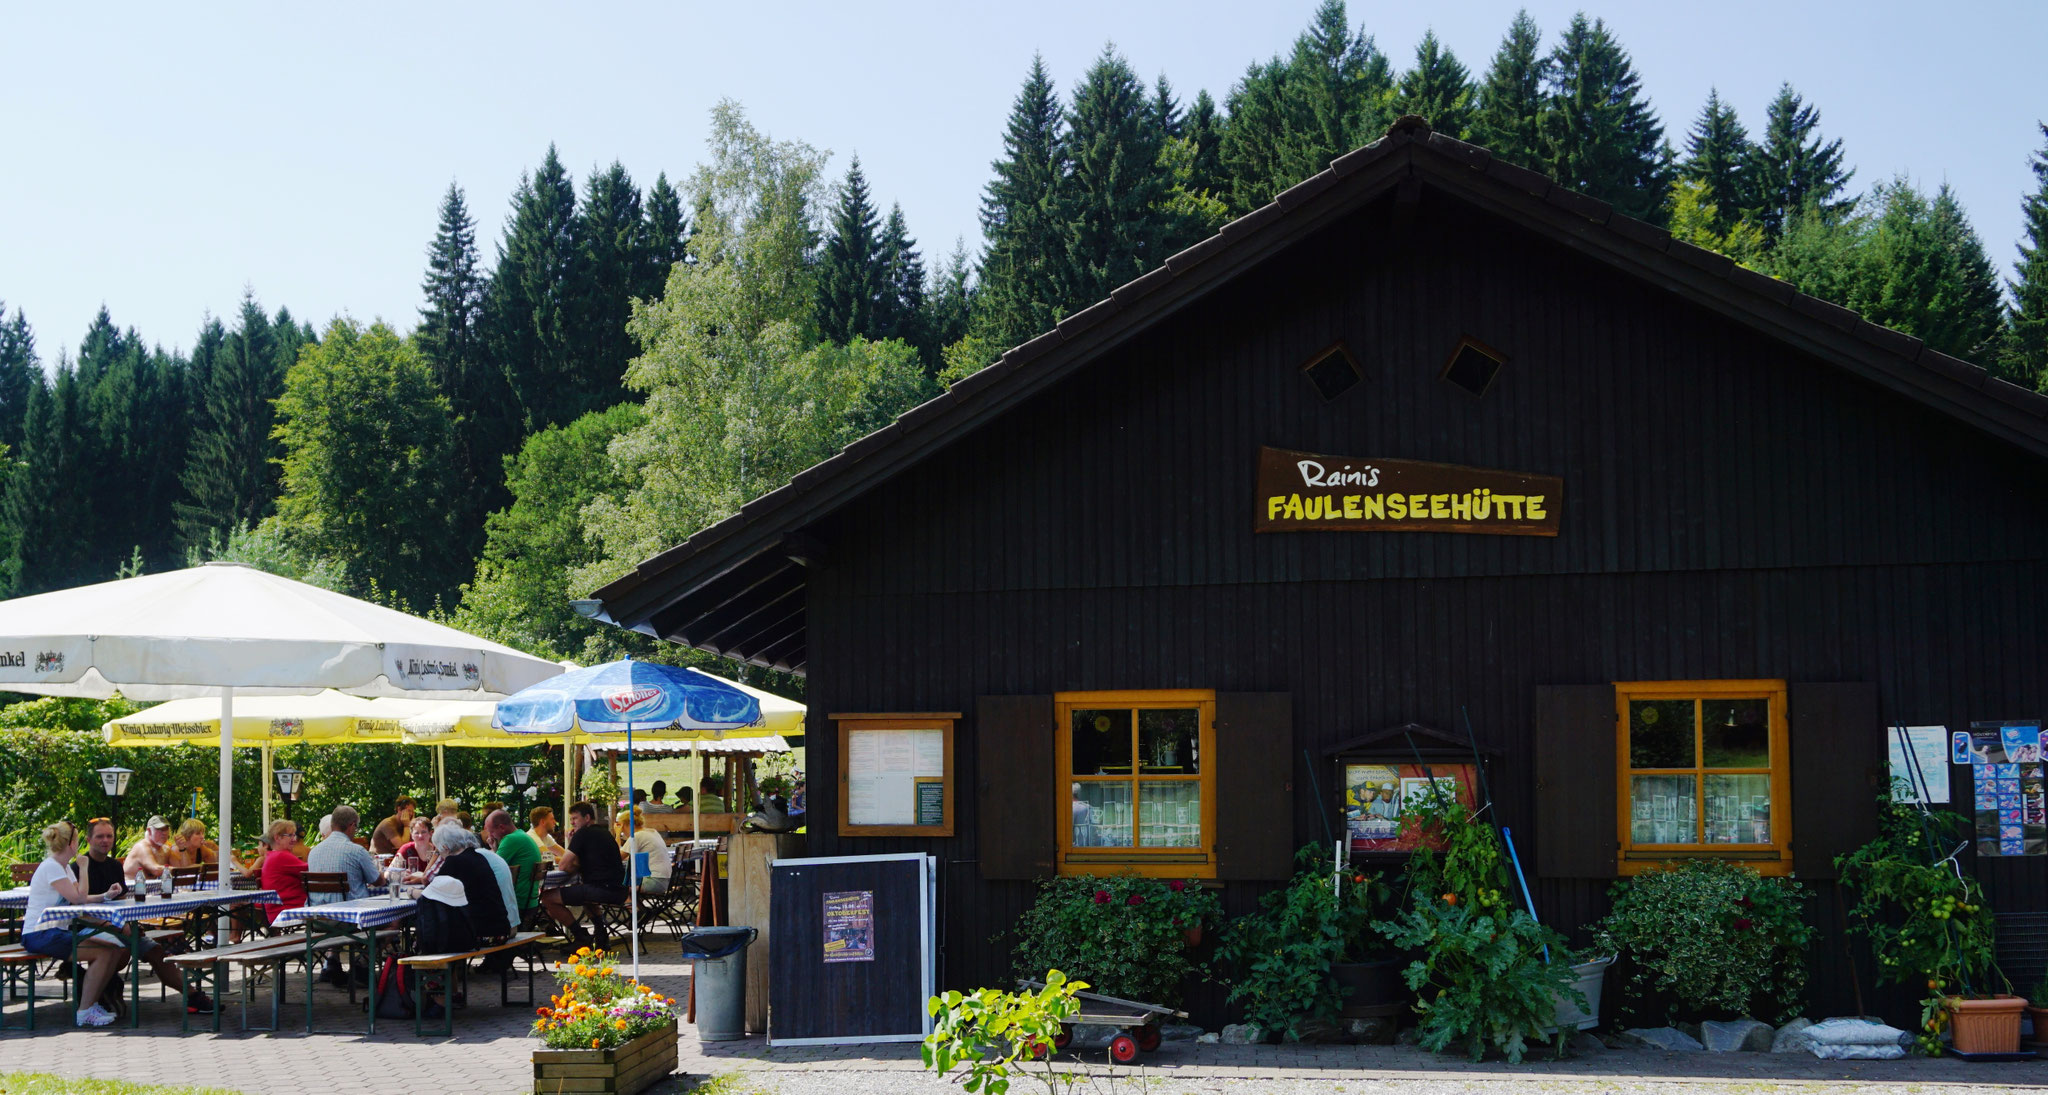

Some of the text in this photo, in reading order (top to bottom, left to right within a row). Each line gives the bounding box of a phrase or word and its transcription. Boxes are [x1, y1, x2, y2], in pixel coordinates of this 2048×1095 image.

[1297, 459, 1380, 488] Rainis
[1268, 488, 1547, 521] FAULENSEEHÜTTE
[612, 688, 657, 713] Schöller
[119, 722, 212, 738] König Ludwig Weissbier
